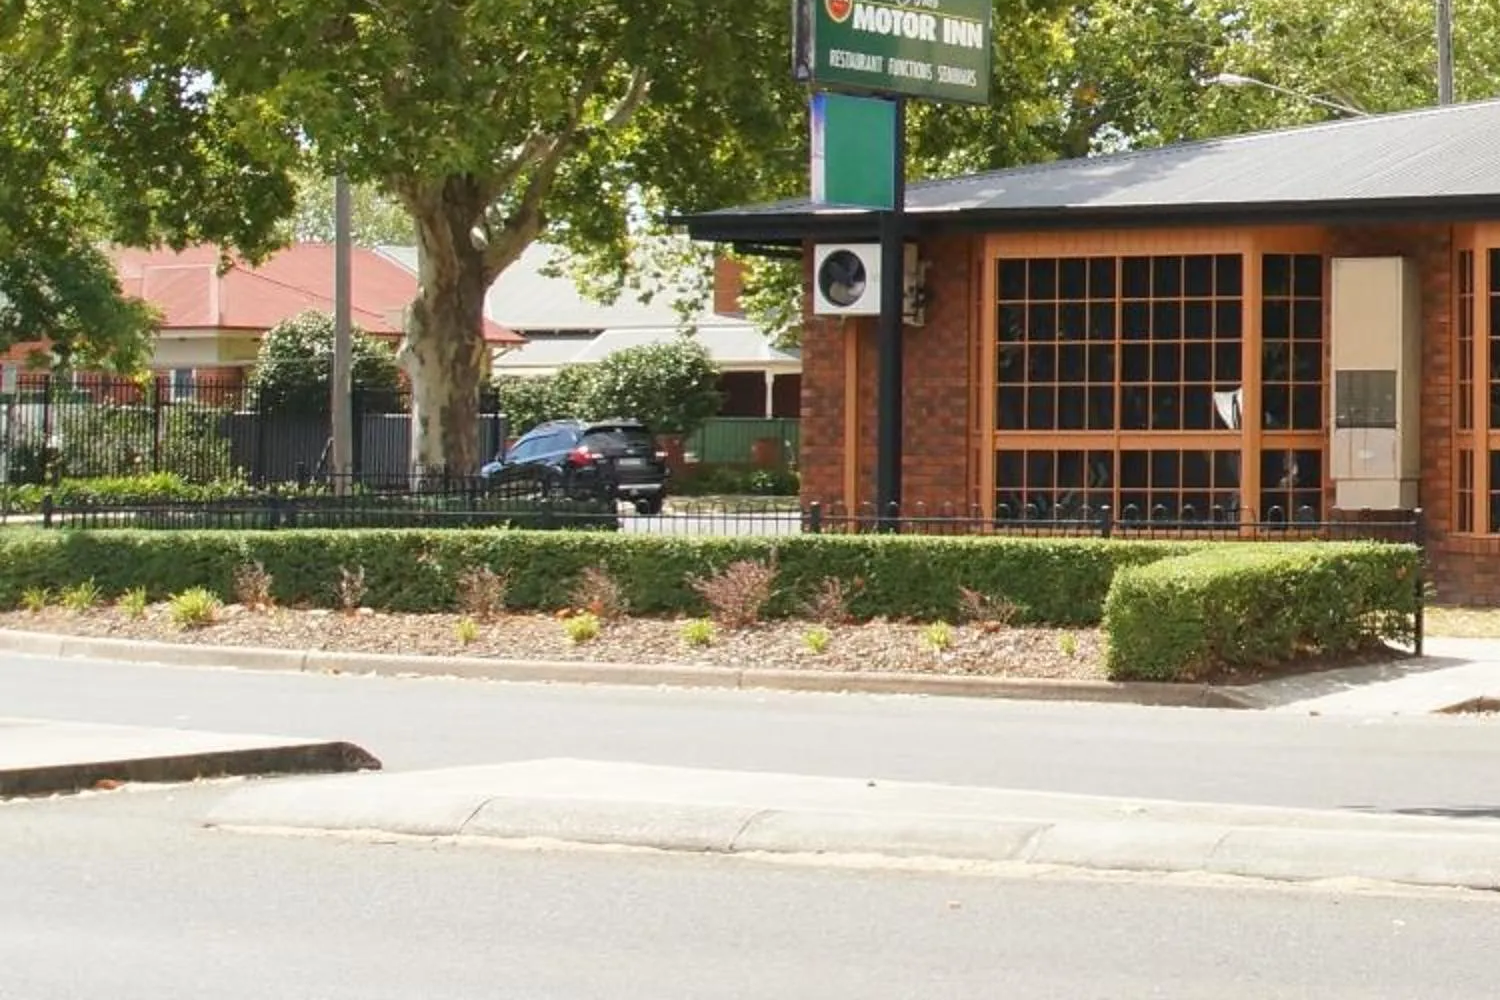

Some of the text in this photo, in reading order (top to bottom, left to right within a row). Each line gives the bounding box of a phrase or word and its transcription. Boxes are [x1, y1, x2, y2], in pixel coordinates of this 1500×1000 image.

[852, 3, 983, 49] MOTOR INN
[829, 48, 883, 73] RESTAURANT
[888, 57, 933, 81] FUNCTIONS
